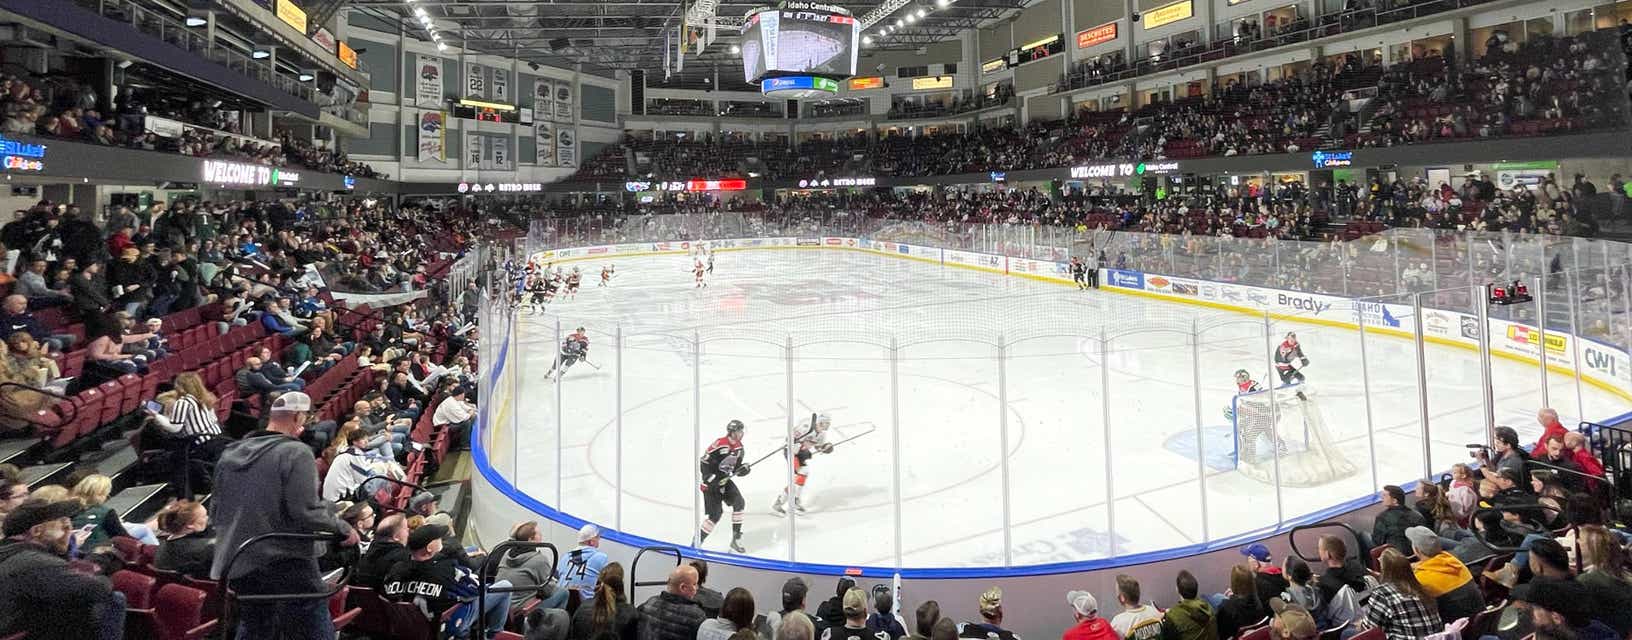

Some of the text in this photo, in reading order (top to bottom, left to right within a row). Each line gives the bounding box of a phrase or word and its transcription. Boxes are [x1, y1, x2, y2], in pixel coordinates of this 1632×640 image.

[787, 1, 809, 9] Idaho
[470, 79, 483, 91] 22
[204, 160, 251, 184] WELCOME
[257, 166, 270, 185] TO
[1070, 163, 1134, 178] WELCOME TO
[1278, 294, 1323, 315] Brady
[1585, 347, 1617, 376] CWI
[565, 560, 587, 581] 24
